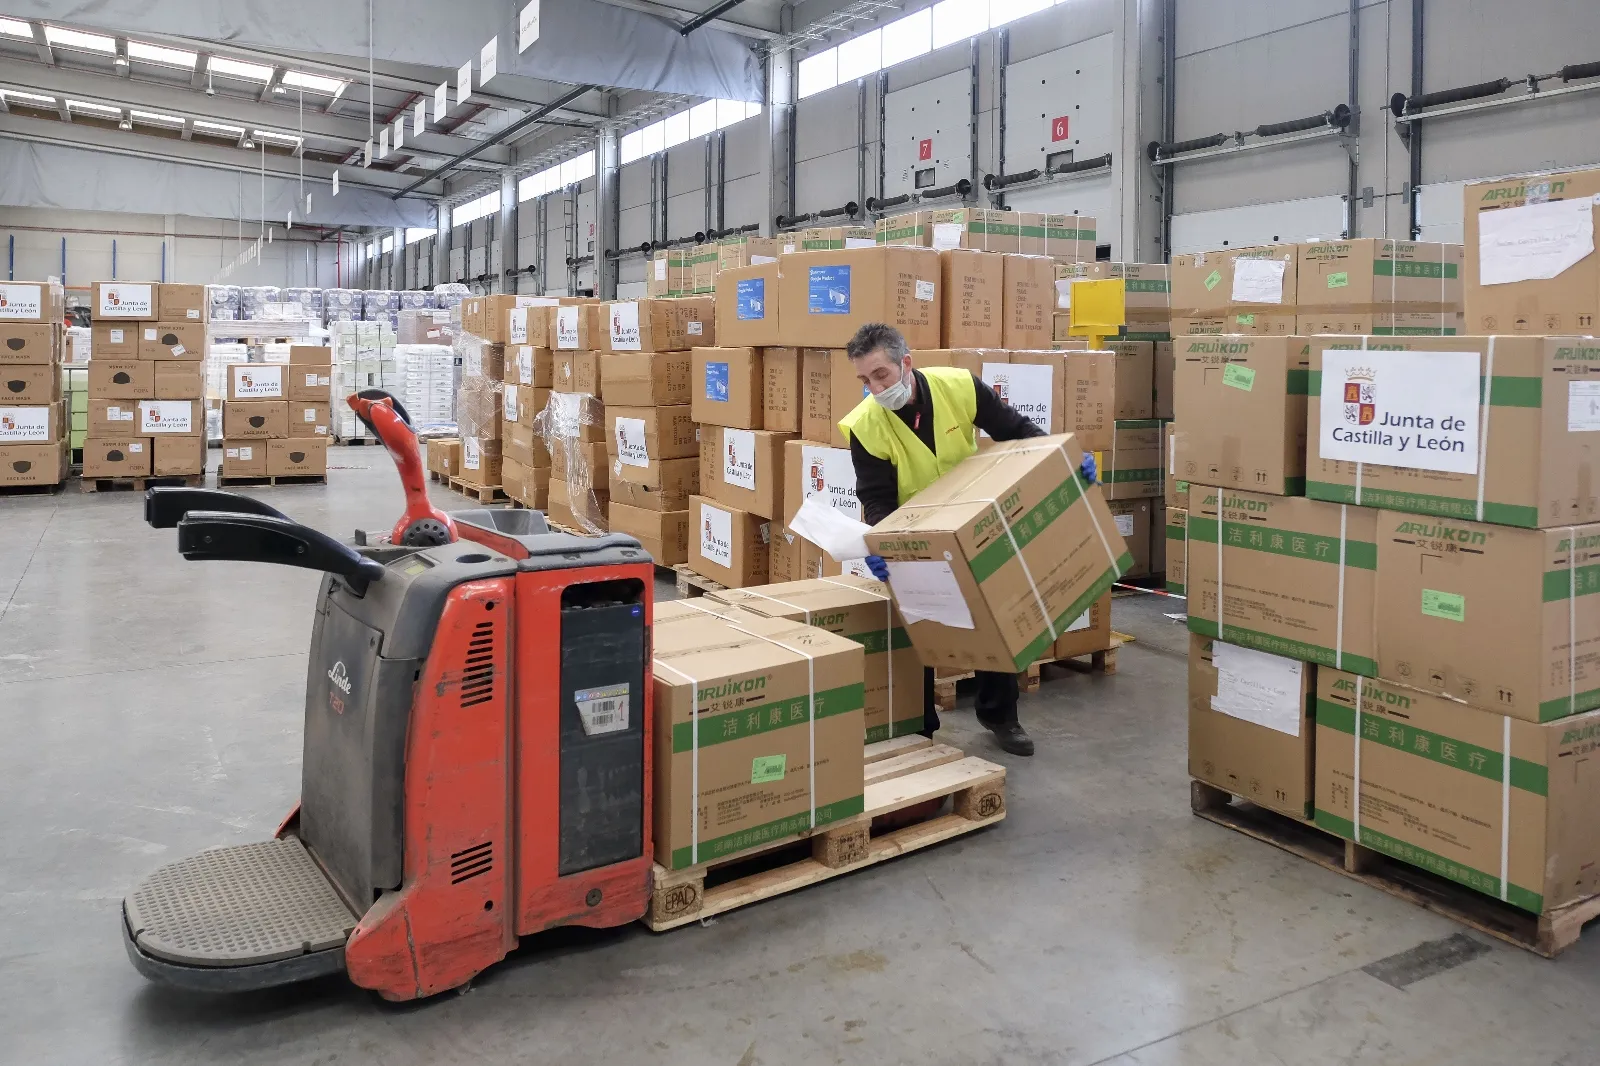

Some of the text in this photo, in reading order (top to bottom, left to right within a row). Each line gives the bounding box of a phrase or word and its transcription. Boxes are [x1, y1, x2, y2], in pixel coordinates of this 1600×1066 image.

[1056, 121, 1064, 136] 6
[922, 143, 929, 157] 7
[1036, 403, 1047, 412] de
[1030, 414, 1046, 425] eón
[1380, 411, 1466, 431] Junta de
[1332, 427, 1464, 452] Castilla y León
[847, 485, 857, 497] de
[832, 498, 857, 509] y León
[1344, 489, 1478, 516] 河洁利康医疗用品有限公
[1229, 527, 1330, 557] 洁利康医疗
[1416, 539, 1458, 553] 艾锐康
[328, 661, 351, 694] Linde
[710, 697, 745, 713] 艾锐康
[1363, 718, 1487, 770] 洁利康医疗
[1361, 831, 1494, 894] 南洁利康医疗用品有限公司
[665, 888, 690, 911] EPAL
